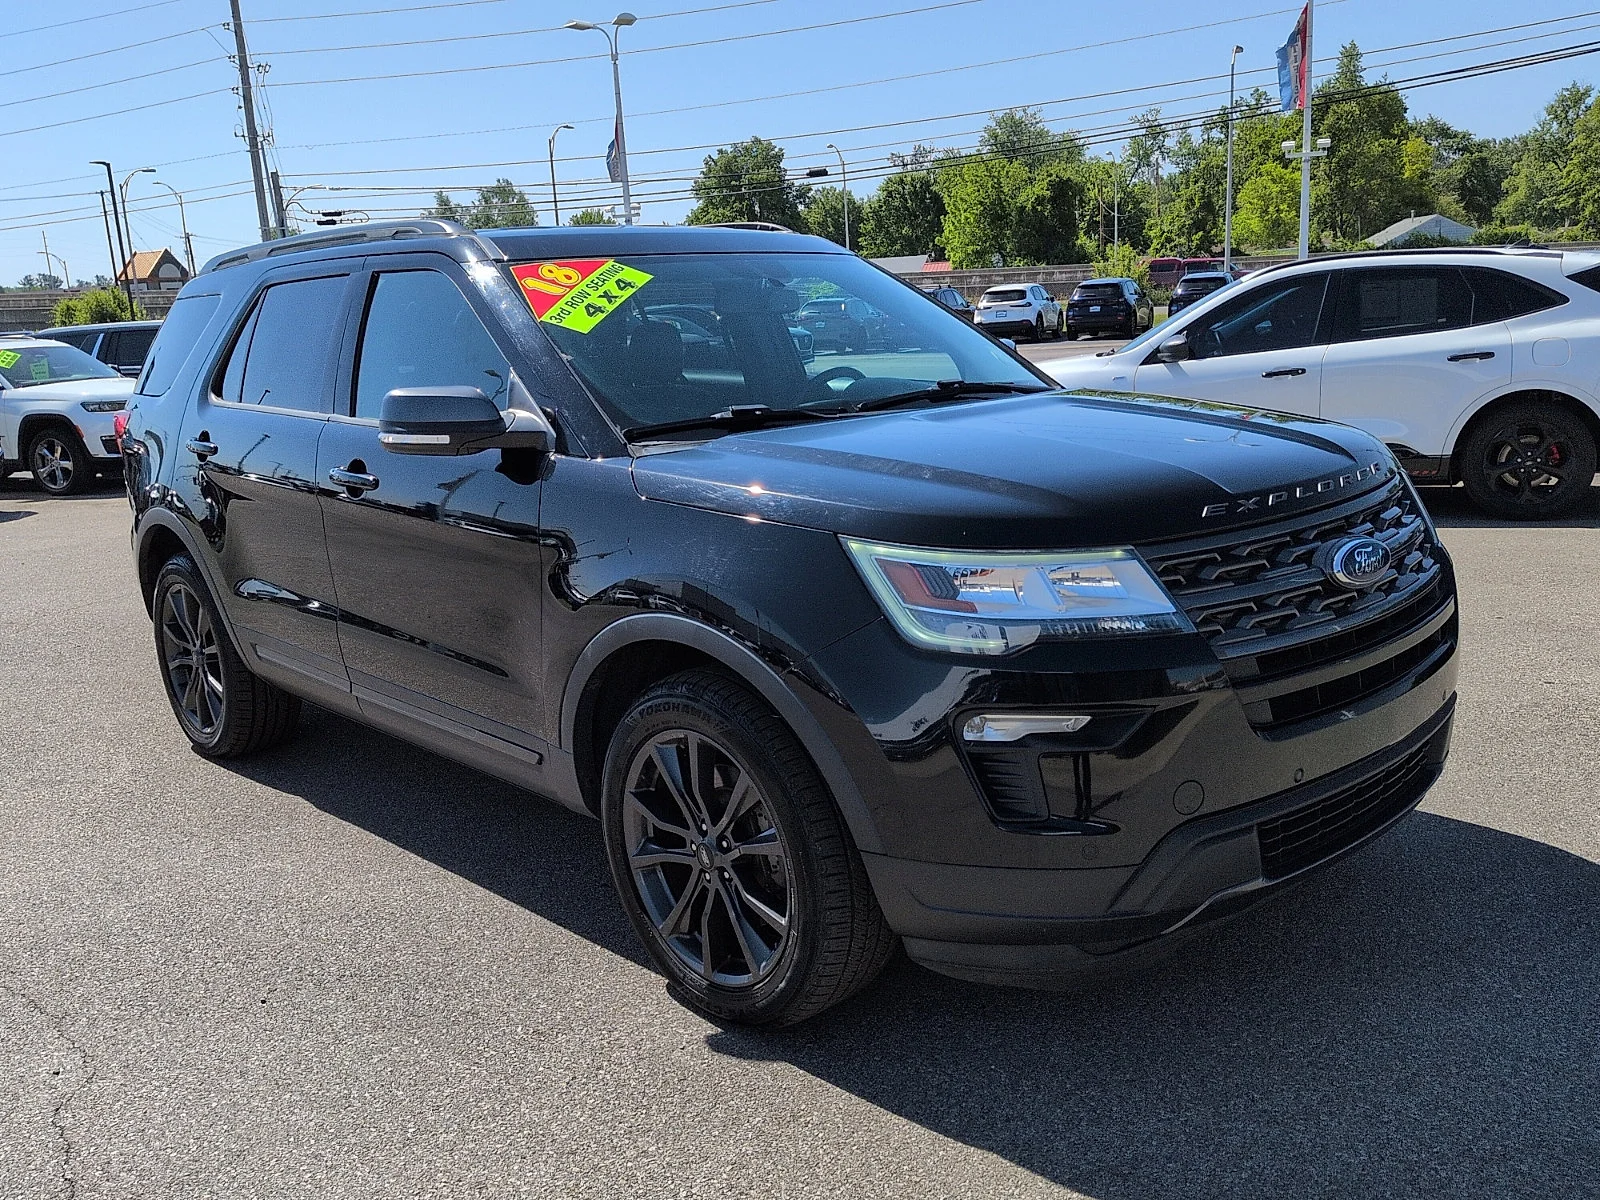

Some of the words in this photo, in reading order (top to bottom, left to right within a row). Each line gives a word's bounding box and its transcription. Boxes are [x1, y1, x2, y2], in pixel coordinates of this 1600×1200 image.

[521, 264, 582, 295] 18
[550, 307, 571, 324] 3rd
[566, 289, 592, 311] ROW
[585, 263, 625, 292] SEATING
[1202, 461, 1381, 518] EXPLORER
[1354, 546, 1385, 576] Ford
